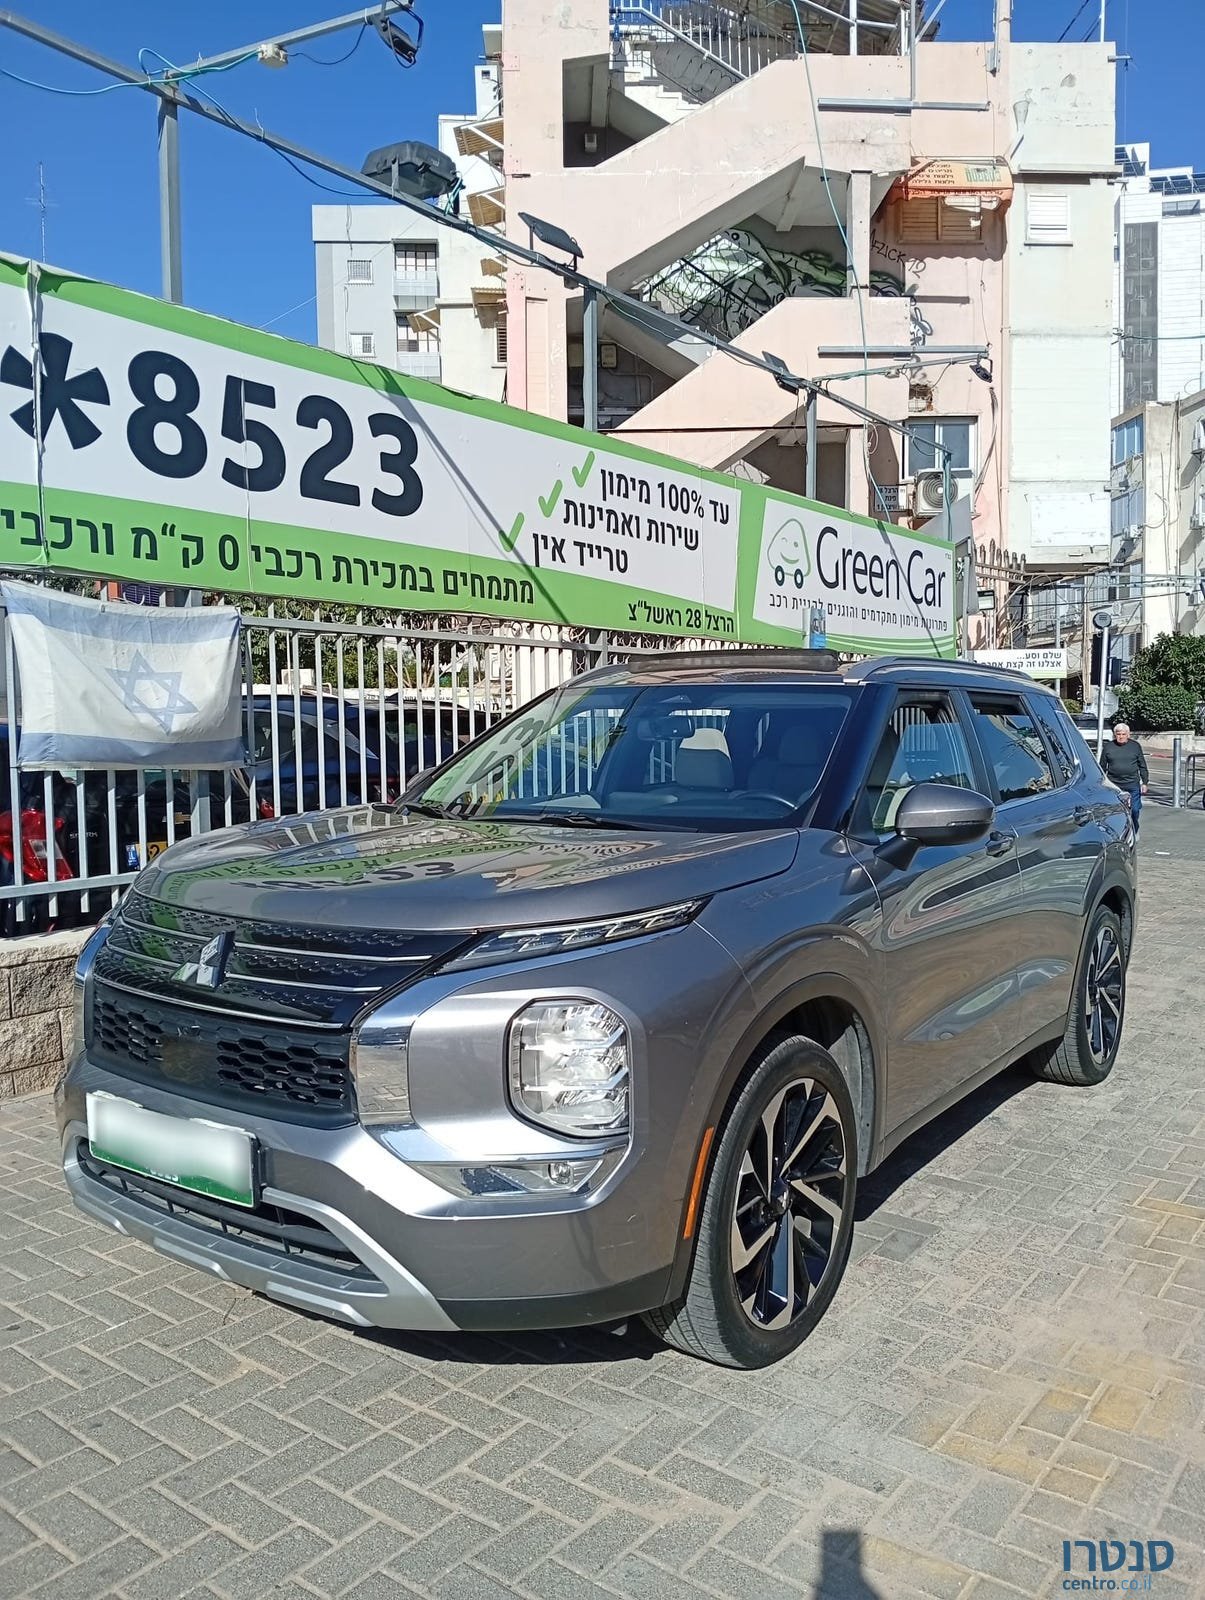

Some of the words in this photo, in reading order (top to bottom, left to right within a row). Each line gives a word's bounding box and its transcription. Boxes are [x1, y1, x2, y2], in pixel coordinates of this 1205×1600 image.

[600, 468, 651, 505] מימון
[657, 481, 705, 518] 100%
[563, 498, 641, 539] ואמינות
[708, 499, 730, 526] עד
[0, 508, 114, 556] ורכבי
[646, 518, 700, 551] שירות
[219, 534, 240, 572] 0
[250, 543, 323, 581] רכבי
[532, 532, 567, 568] אין
[573, 540, 629, 574] טרייד
[816, 526, 900, 601] Green
[907, 549, 946, 608] Car
[332, 554, 435, 594] במכירת
[442, 569, 535, 605] מתמחים
[769, 593, 789, 608] רכב
[827, 603, 859, 619] והוגנים
[861, 607, 897, 625] מתקדמים
[685, 607, 702, 629] 28
[705, 609, 734, 633] הרצל
[899, 614, 919, 629] מימון
[920, 617, 948, 632] פתרונות
[1043, 651, 1062, 659] שלם
